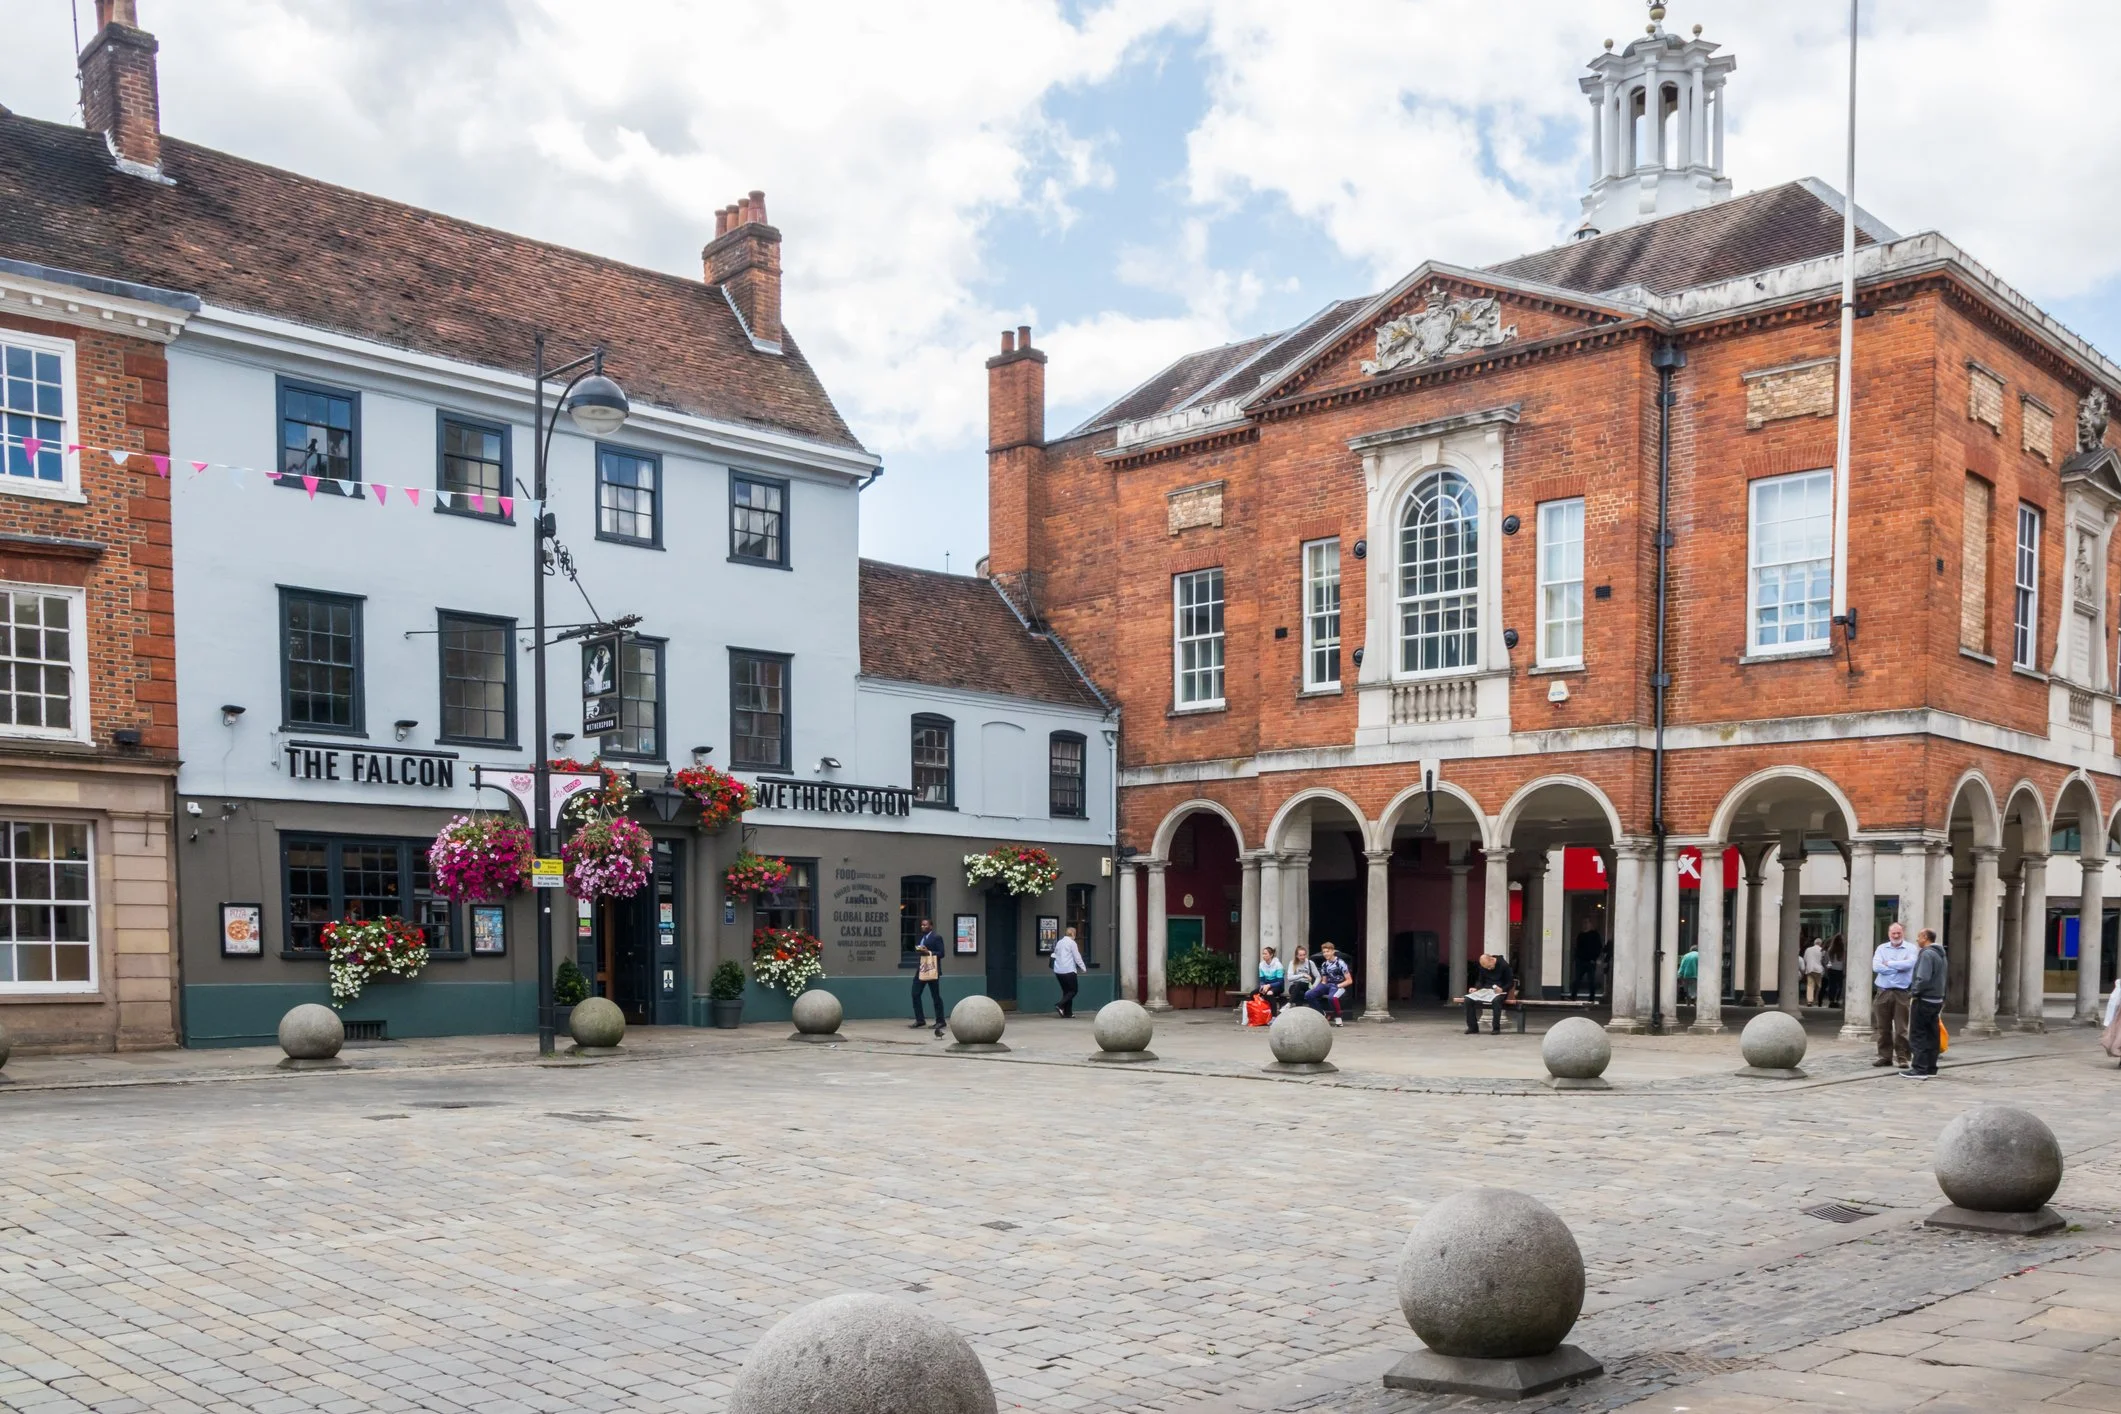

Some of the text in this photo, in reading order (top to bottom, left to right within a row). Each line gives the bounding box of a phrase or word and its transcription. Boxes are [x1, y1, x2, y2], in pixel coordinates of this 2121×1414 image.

[586, 720, 614, 731] WETHERSPOON
[284, 747, 453, 788] THE FALCON
[756, 783, 910, 817] WETHERSPOON
[835, 868, 856, 880] FOOD
[833, 910, 889, 923] GLOBAL BEERS
[840, 925, 883, 937] CASK ALES
